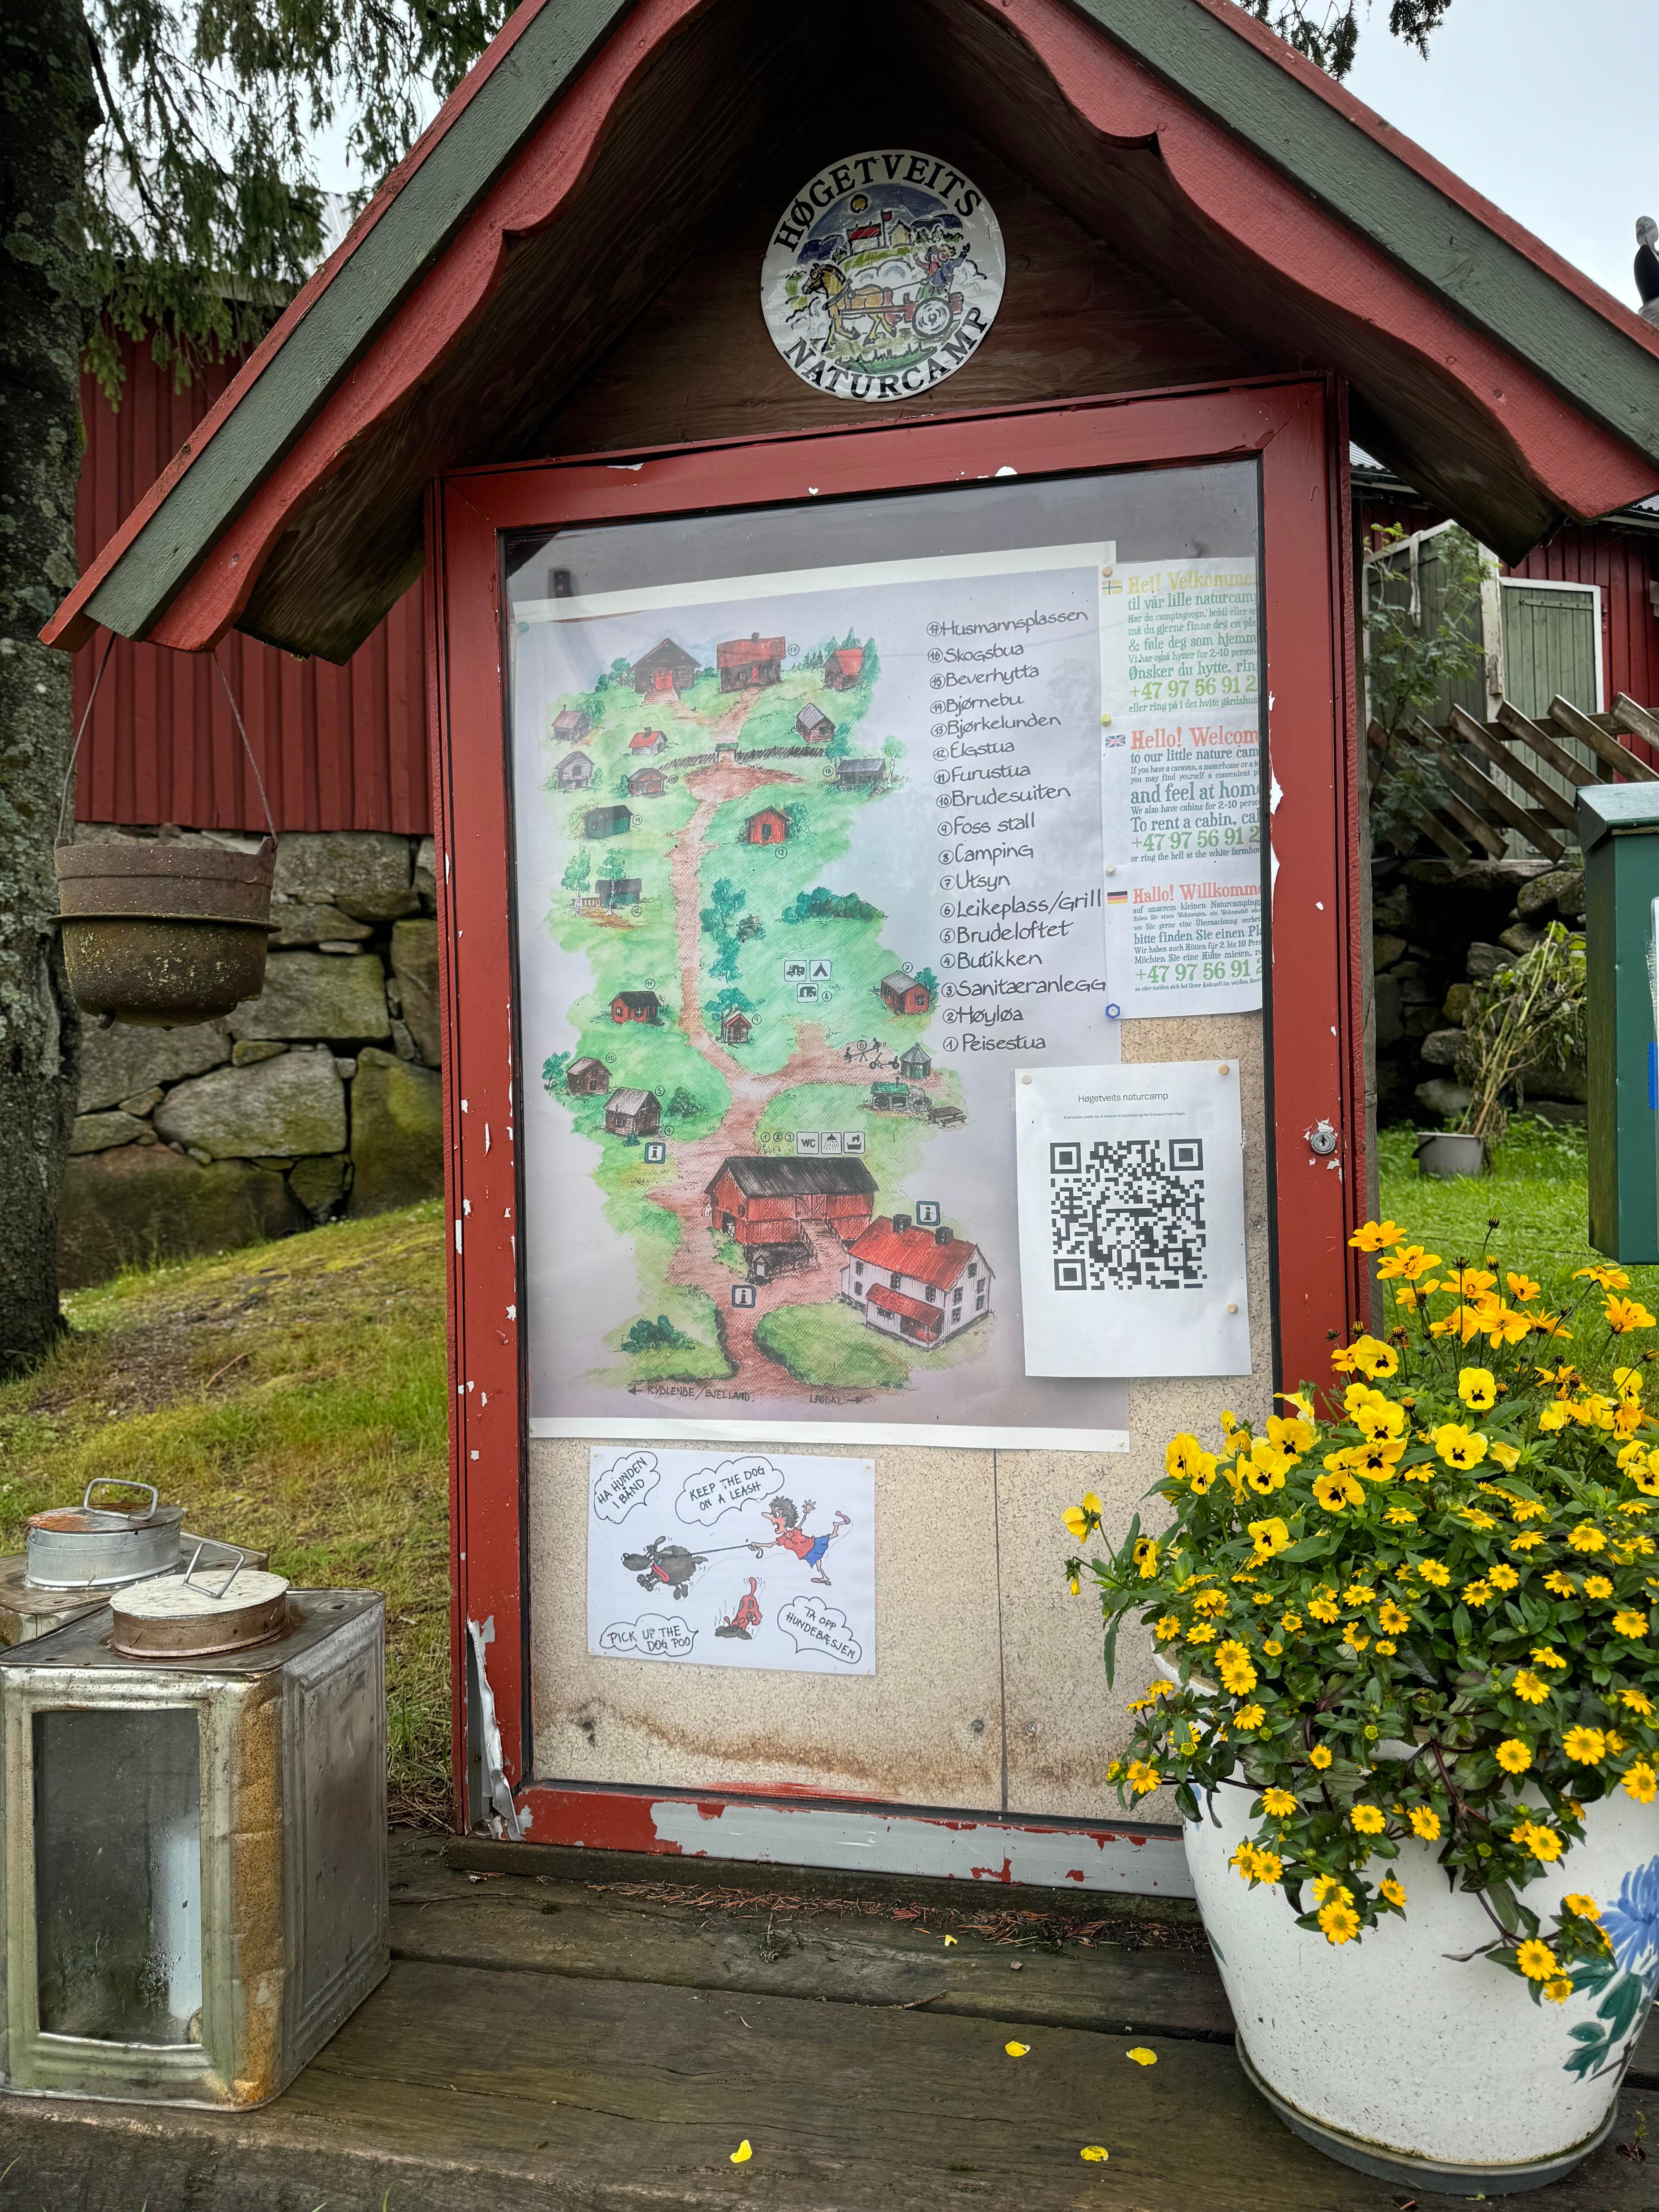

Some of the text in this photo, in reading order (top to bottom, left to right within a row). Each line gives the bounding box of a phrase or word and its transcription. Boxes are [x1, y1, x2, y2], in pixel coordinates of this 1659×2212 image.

[774, 154, 982, 252] HØGETVEITS
[783, 307, 988, 399] NATURCAMP
[1127, 570, 1255, 594] Hei! Velkomme
[1128, 596, 1140, 610] til
[1144, 596, 1164, 609] vår
[1168, 592, 1192, 607] lille
[942, 610, 1089, 636] Husmannsplassen
[1128, 639, 1139, 652] &
[1144, 636, 1164, 650] føle
[1168, 635, 1187, 650] deg
[1190, 637, 1213, 647] som
[946, 665, 1039, 687] Beverhytta
[1129, 664, 1174, 680] Ønsker
[1178, 661, 1193, 676] du
[1236, 659, 1256, 672] rin
[1130, 682, 1163, 700] +47
[1168, 680, 1190, 697] 97
[1195, 678, 1216, 696] 56
[1221, 676, 1240, 694] 91
[946, 693, 1025, 717] Bjørnebu
[1129, 702, 1147, 713] eller
[1149, 702, 1166, 712] ring
[1168, 701, 1178, 711] på
[1185, 699, 1197, 708] det
[1199, 698, 1219, 707] hvite
[947, 713, 1061, 738] Bjørkelunden
[1129, 726, 1182, 750] Hello!
[1131, 751, 1140, 763] to
[1144, 753, 1163, 763] our
[1166, 748, 1192, 761] little
[1196, 749, 1232, 759] nature
[952, 764, 1031, 782] Furustua
[1179, 772, 1205, 781] yourself
[1216, 770, 1250, 778] convenient
[952, 784, 1071, 807] Brudesuiten
[1131, 783, 1161, 804] and
[1165, 781, 1195, 802] feel
[1199, 784, 1214, 800] at
[954, 816, 991, 835] Foss
[997, 812, 1034, 833] stall
[1130, 816, 1147, 832] To
[1151, 816, 1179, 831] rent
[1183, 818, 1191, 828] a
[1195, 812, 1237, 828] cabin,
[1132, 833, 1165, 851] +47
[1170, 831, 1192, 849] 97
[1197, 829, 1219, 848] 56
[1224, 827, 1244, 845] 91
[957, 869, 1010, 891] Utsyn
[1133, 884, 1173, 904] Hallo!
[1133, 905, 1144, 914] auf
[1181, 902, 1206, 910] kleinen
[957, 920, 1074, 943] Brudeloftet
[1134, 933, 1156, 945] bitte
[1159, 930, 1193, 943] finden
[1196, 929, 1212, 941] Sie
[1216, 929, 1245, 939] einen
[958, 949, 1042, 969] Butikken
[1135, 955, 1166, 964] Möchten
[1168, 954, 1180, 962] Sie
[1202, 951, 1221, 960] Hütte
[1135, 965, 1170, 983] +47
[1175, 963, 1197, 981] 97
[1203, 962, 1225, 980] 56
[1231, 959, 1250, 977] 91
[957, 1005, 1024, 1026] Høyløa
[962, 1033, 1046, 1052] Peisestua
[1079, 1094, 1121, 1104] Høgetveits
[801, 1139, 816, 1147] WC
[597, 1457, 648, 1504] HA HUNDEN
[690, 1466, 765, 1501] KEEP THE DOG
[619, 1479, 645, 1505] BÅND
[700, 1481, 761, 1510] ON A LEASH
[804, 1606, 836, 1630] TA OPP
[607, 1626, 681, 1644] PICK UP THE
[648, 1637, 690, 1651] DOG POO
[786, 1612, 855, 1659] HUNDEBÆSJEN
